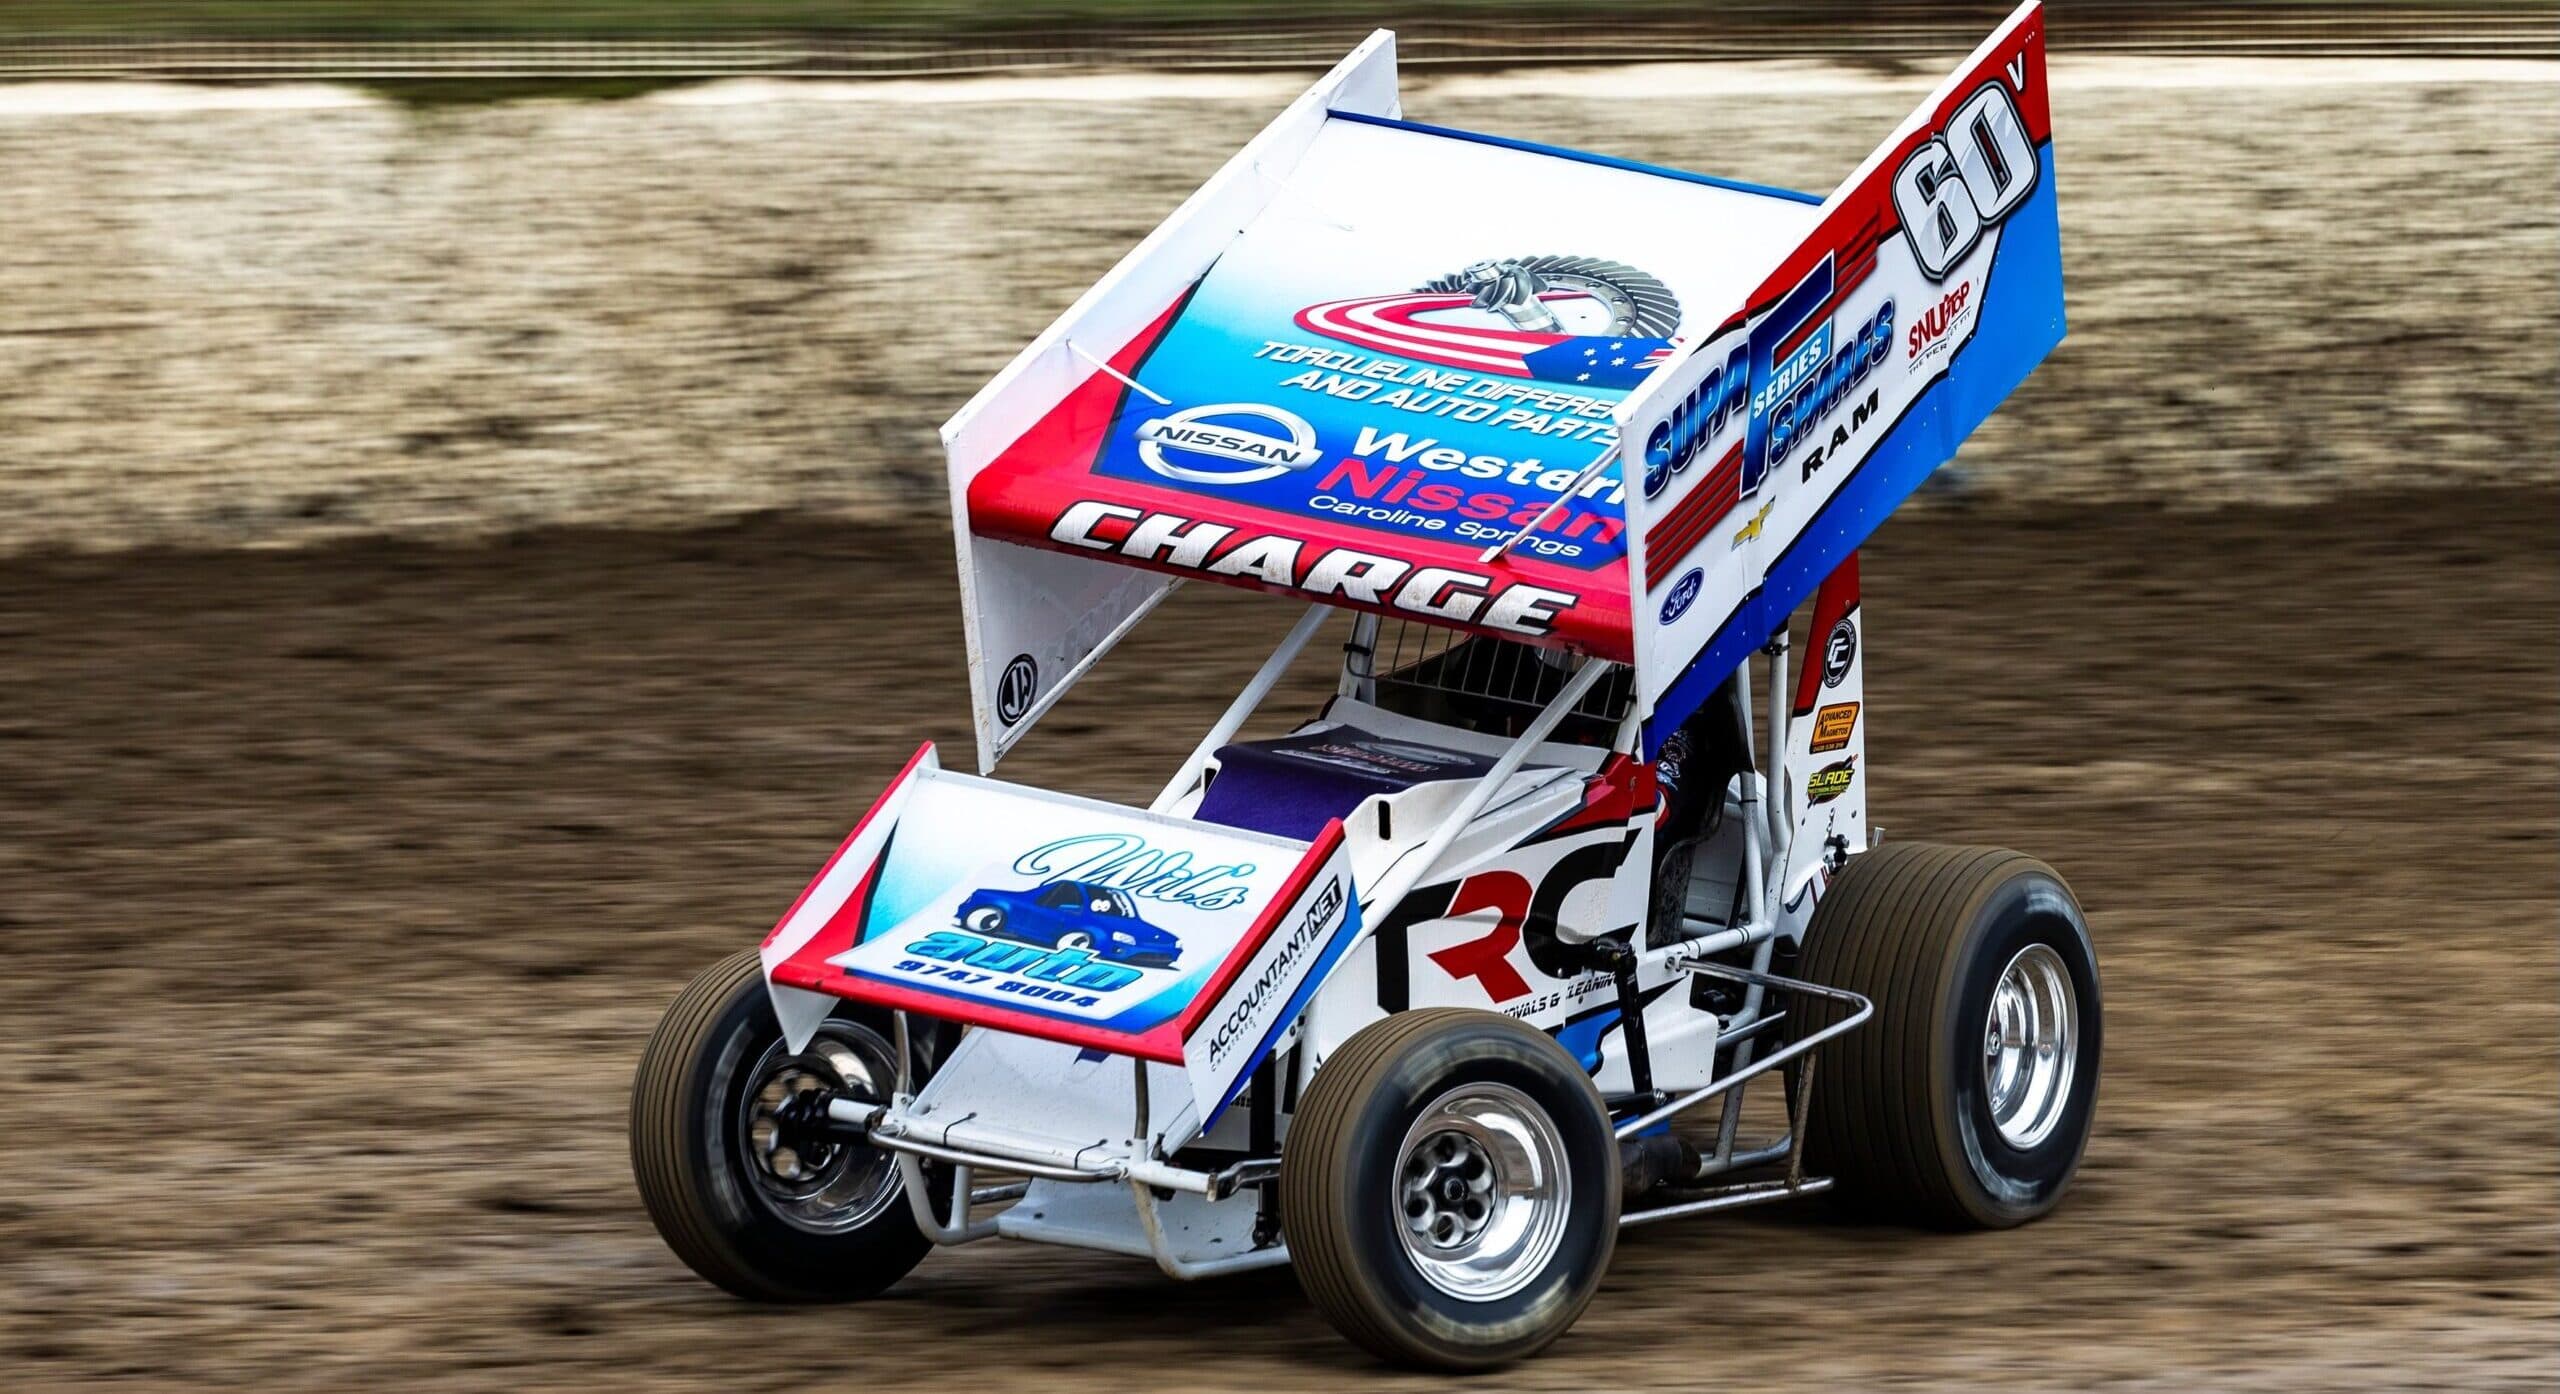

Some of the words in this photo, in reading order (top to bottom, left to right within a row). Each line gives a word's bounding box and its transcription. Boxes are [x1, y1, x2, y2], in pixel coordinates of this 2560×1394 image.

[1892, 80, 2040, 281] 60
[1254, 340, 1474, 392] TORQUELINE
[1752, 336, 1822, 420] SERIES
[1768, 297, 1895, 470] SPARES
[1153, 425, 1302, 464] NISSAN
[1279, 369, 1383, 401] AND
[1369, 389, 1500, 425] AUTO
[1487, 409, 1621, 447] PARTS
[1644, 341, 1749, 500] SUPA
[1802, 386, 1880, 485] RAM
[1308, 494, 1447, 531] Caroline
[1454, 521, 1582, 558] Sprngs
[1315, 457, 1626, 545] Nissan
[1050, 500, 1577, 636] CHARGE
[1818, 710, 1852, 727] ADVANCED
[1808, 769, 1854, 787] SLADE
[894, 960, 992, 985] 9747
[995, 980, 1101, 1008] 8004
[904, 931, 1144, 992] auto
[1208, 921, 1306, 1063] ACCOUNTANT
[1307, 877, 1341, 936] NET
